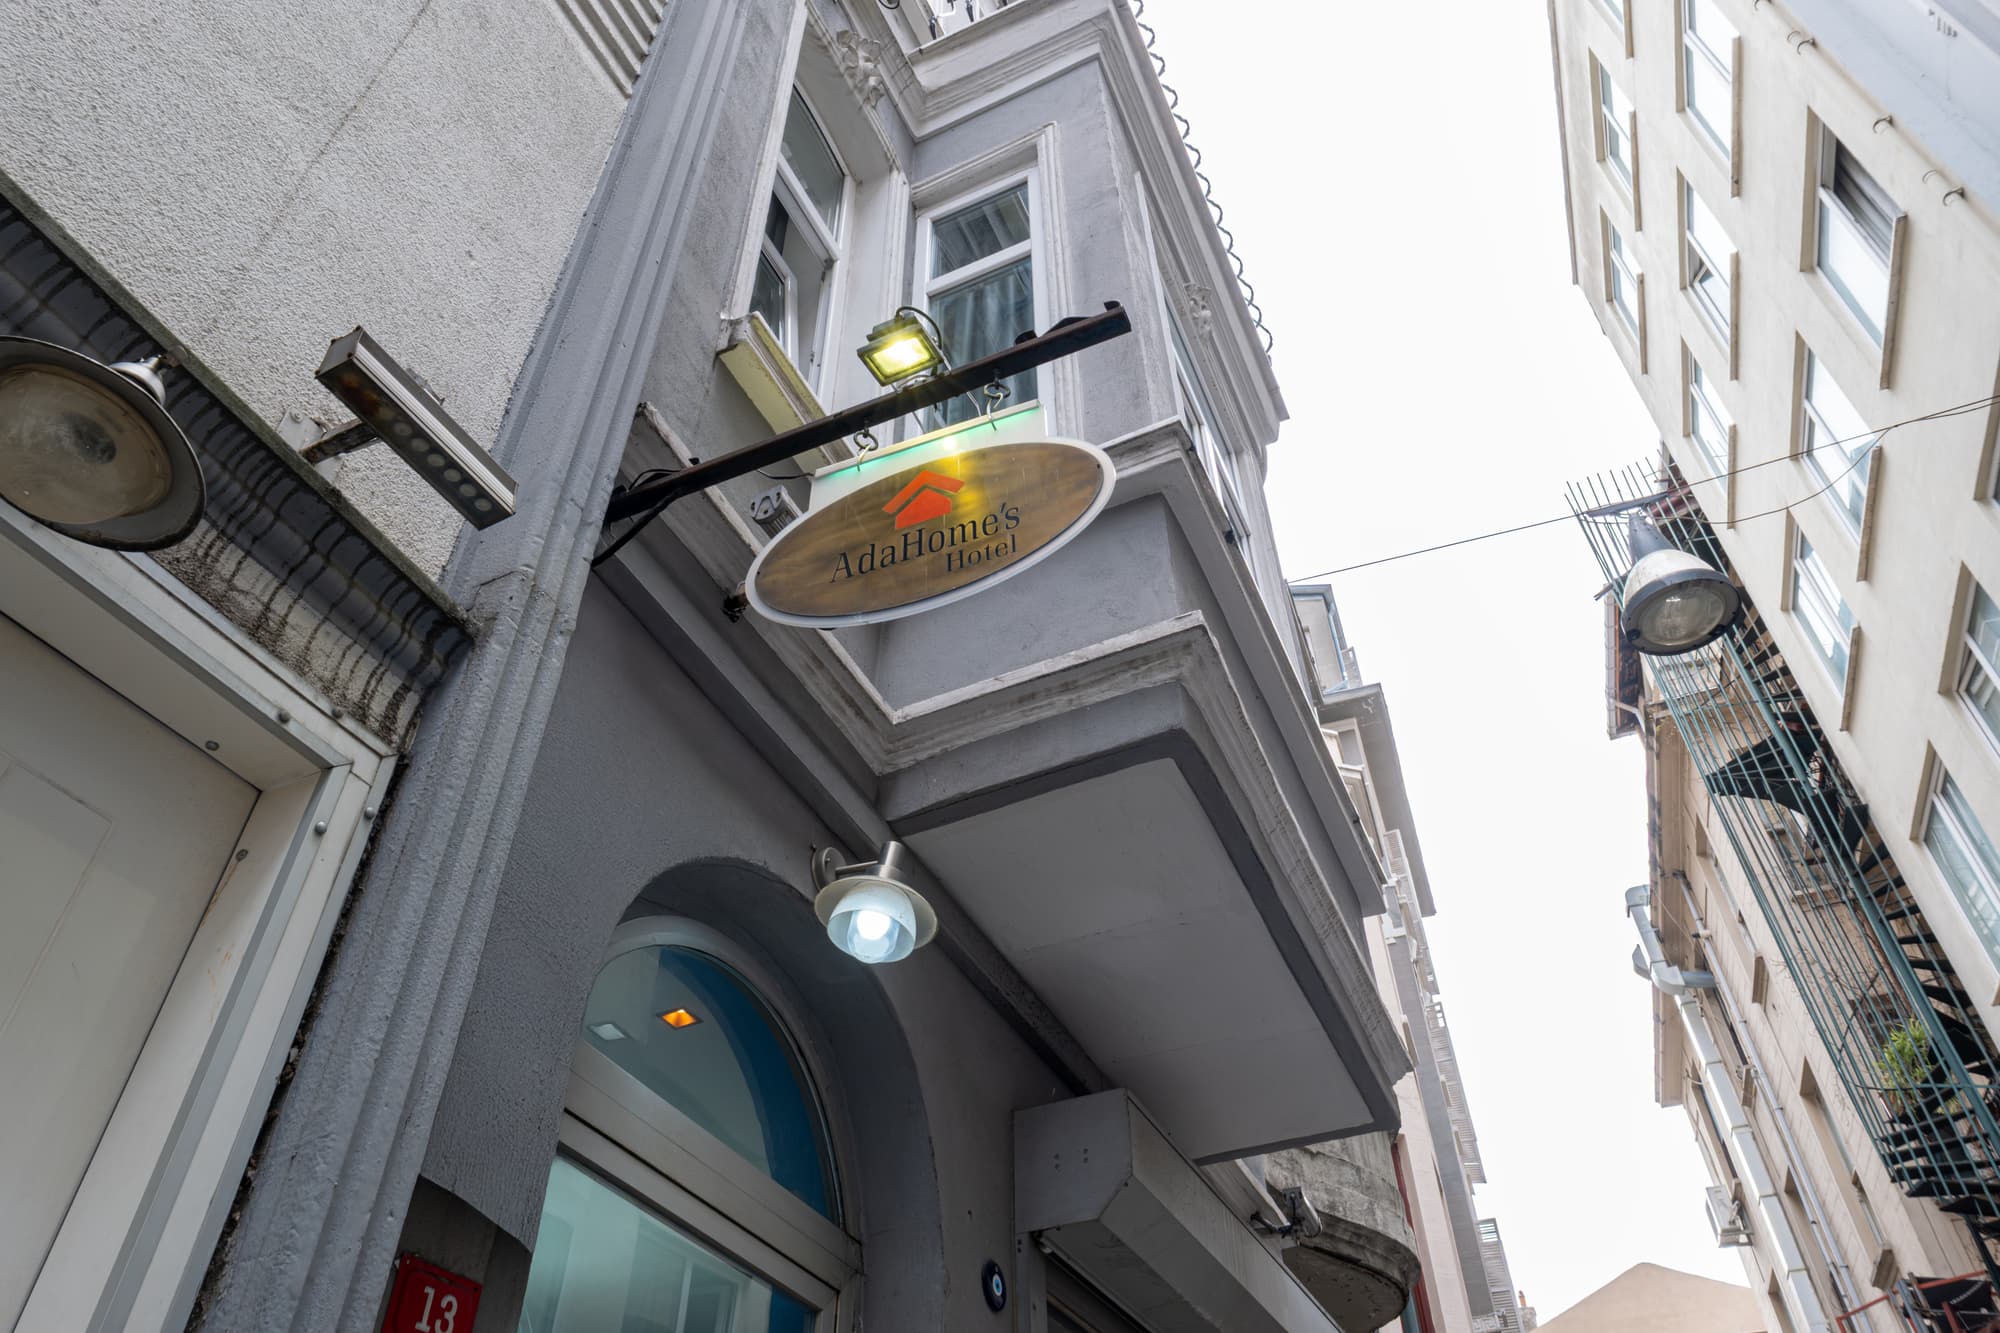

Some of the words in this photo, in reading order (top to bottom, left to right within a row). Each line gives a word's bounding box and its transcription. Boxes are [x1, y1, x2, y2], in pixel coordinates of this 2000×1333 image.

[829, 502, 1020, 583] AdaHome's
[946, 534, 1017, 571] Hotel
[415, 1285, 458, 1333] 13
